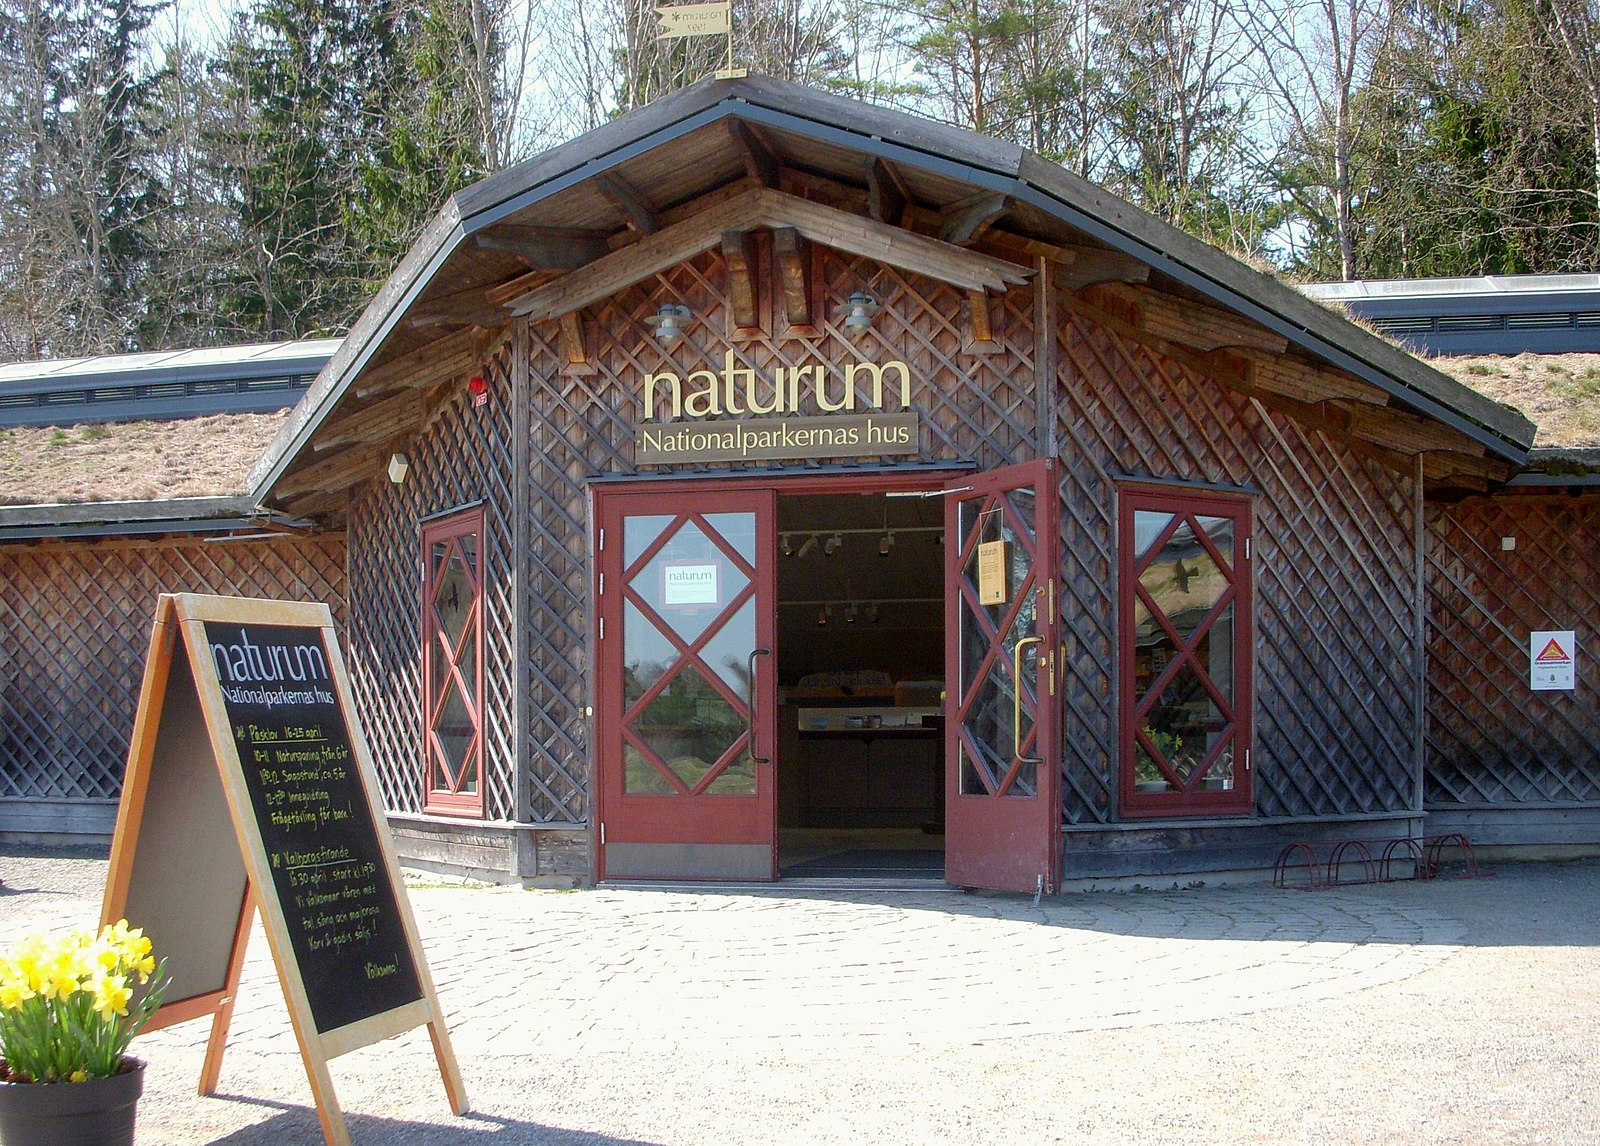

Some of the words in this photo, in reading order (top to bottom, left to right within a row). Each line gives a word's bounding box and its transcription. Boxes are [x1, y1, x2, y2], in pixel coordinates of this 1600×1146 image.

[644, 348, 911, 419] naturum
[643, 424, 859, 456] Nationalparkernas
[867, 419, 910, 444] hus
[669, 570, 712, 581] naturum
[210, 628, 329, 682] naturum
[220, 685, 315, 710] Nationalparkernas
[313, 685, 335, 705] hus
[284, 726, 304, 739] 16-25
[305, 724, 322, 740] april
[319, 806, 331, 826] för
[298, 872, 309, 886] 30
